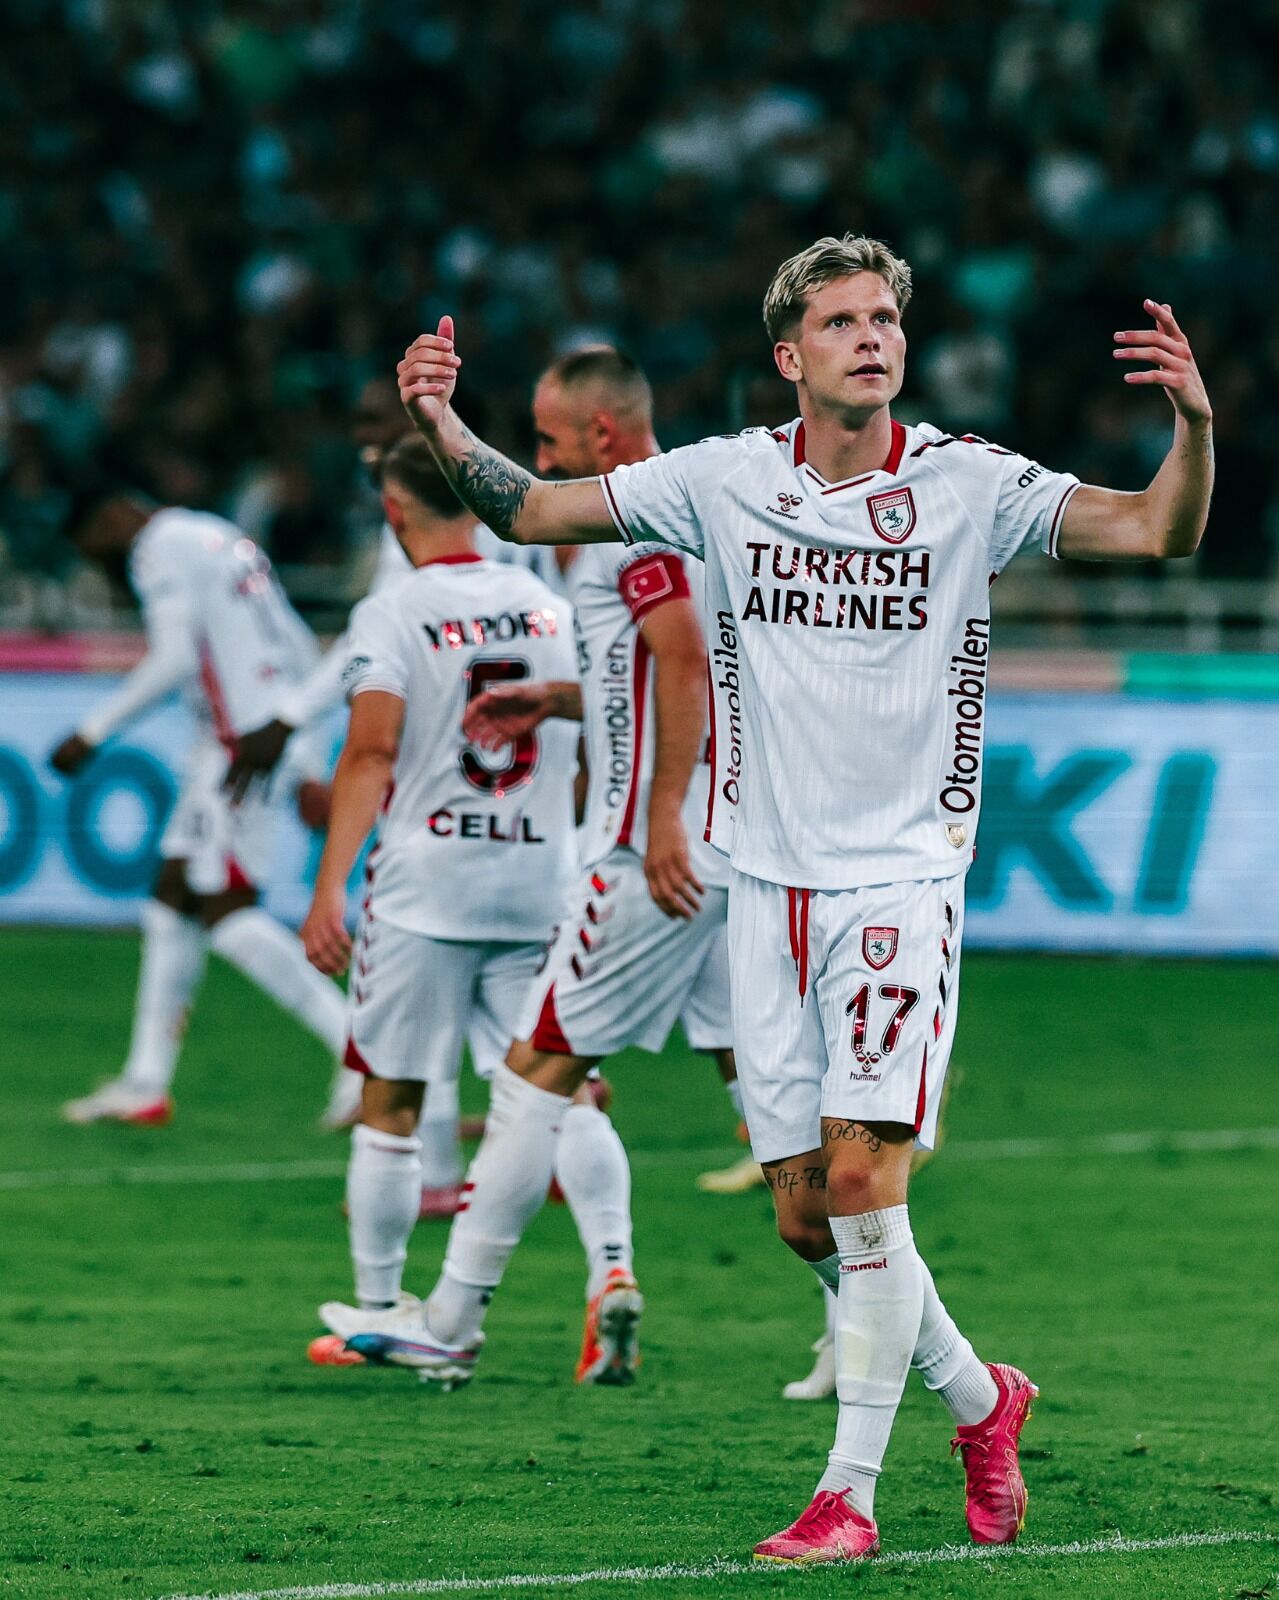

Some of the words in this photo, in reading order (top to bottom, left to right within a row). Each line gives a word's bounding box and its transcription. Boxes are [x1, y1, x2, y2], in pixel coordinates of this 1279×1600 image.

[746, 542, 930, 588] TURKISH
[741, 586, 928, 631] AIRLINES
[458, 657, 542, 797] 5
[714, 610, 742, 807] Otomobilen
[939, 617, 990, 814] Otomobilen
[845, 982, 920, 1056] 17
[849, 1071, 881, 1082] hummel
